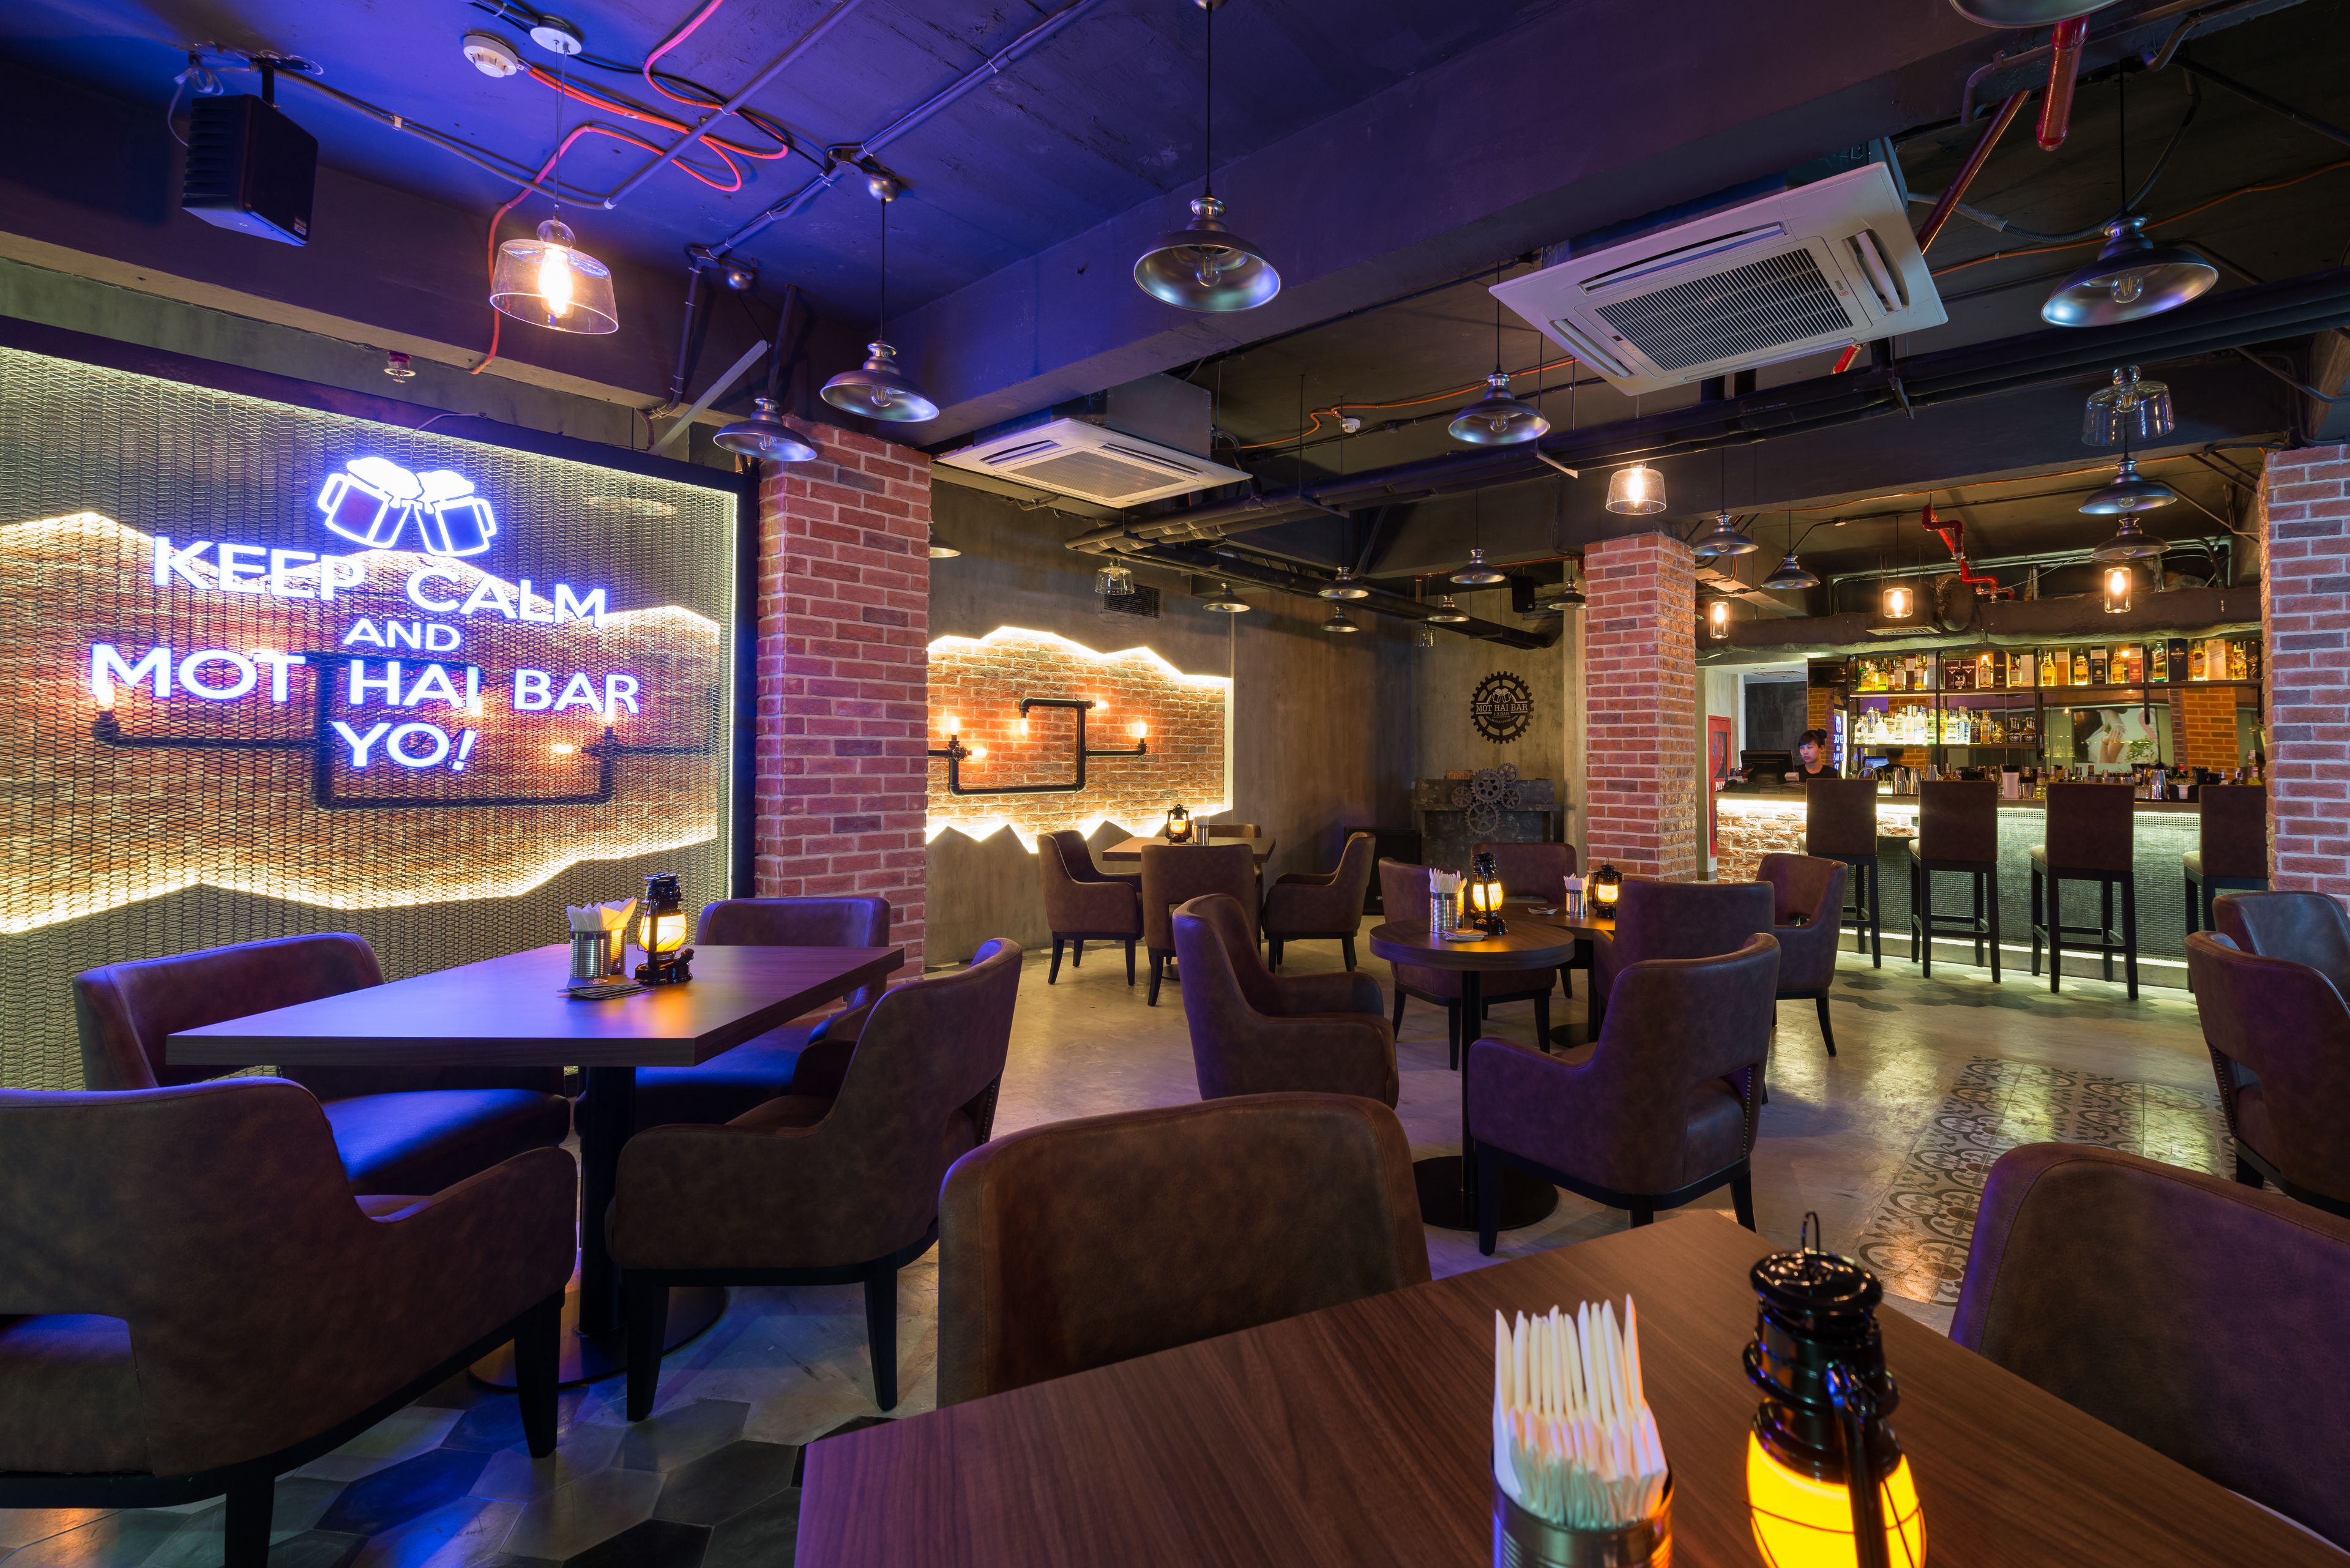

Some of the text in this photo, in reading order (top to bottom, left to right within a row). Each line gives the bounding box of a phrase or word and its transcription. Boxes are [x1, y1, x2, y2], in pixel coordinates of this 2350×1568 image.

[154, 536, 606, 627] KEEP CALM
[343, 618, 461, 651] AND
[91, 644, 640, 714] MOT HAI BAR
[331, 722, 478, 771] YO!
